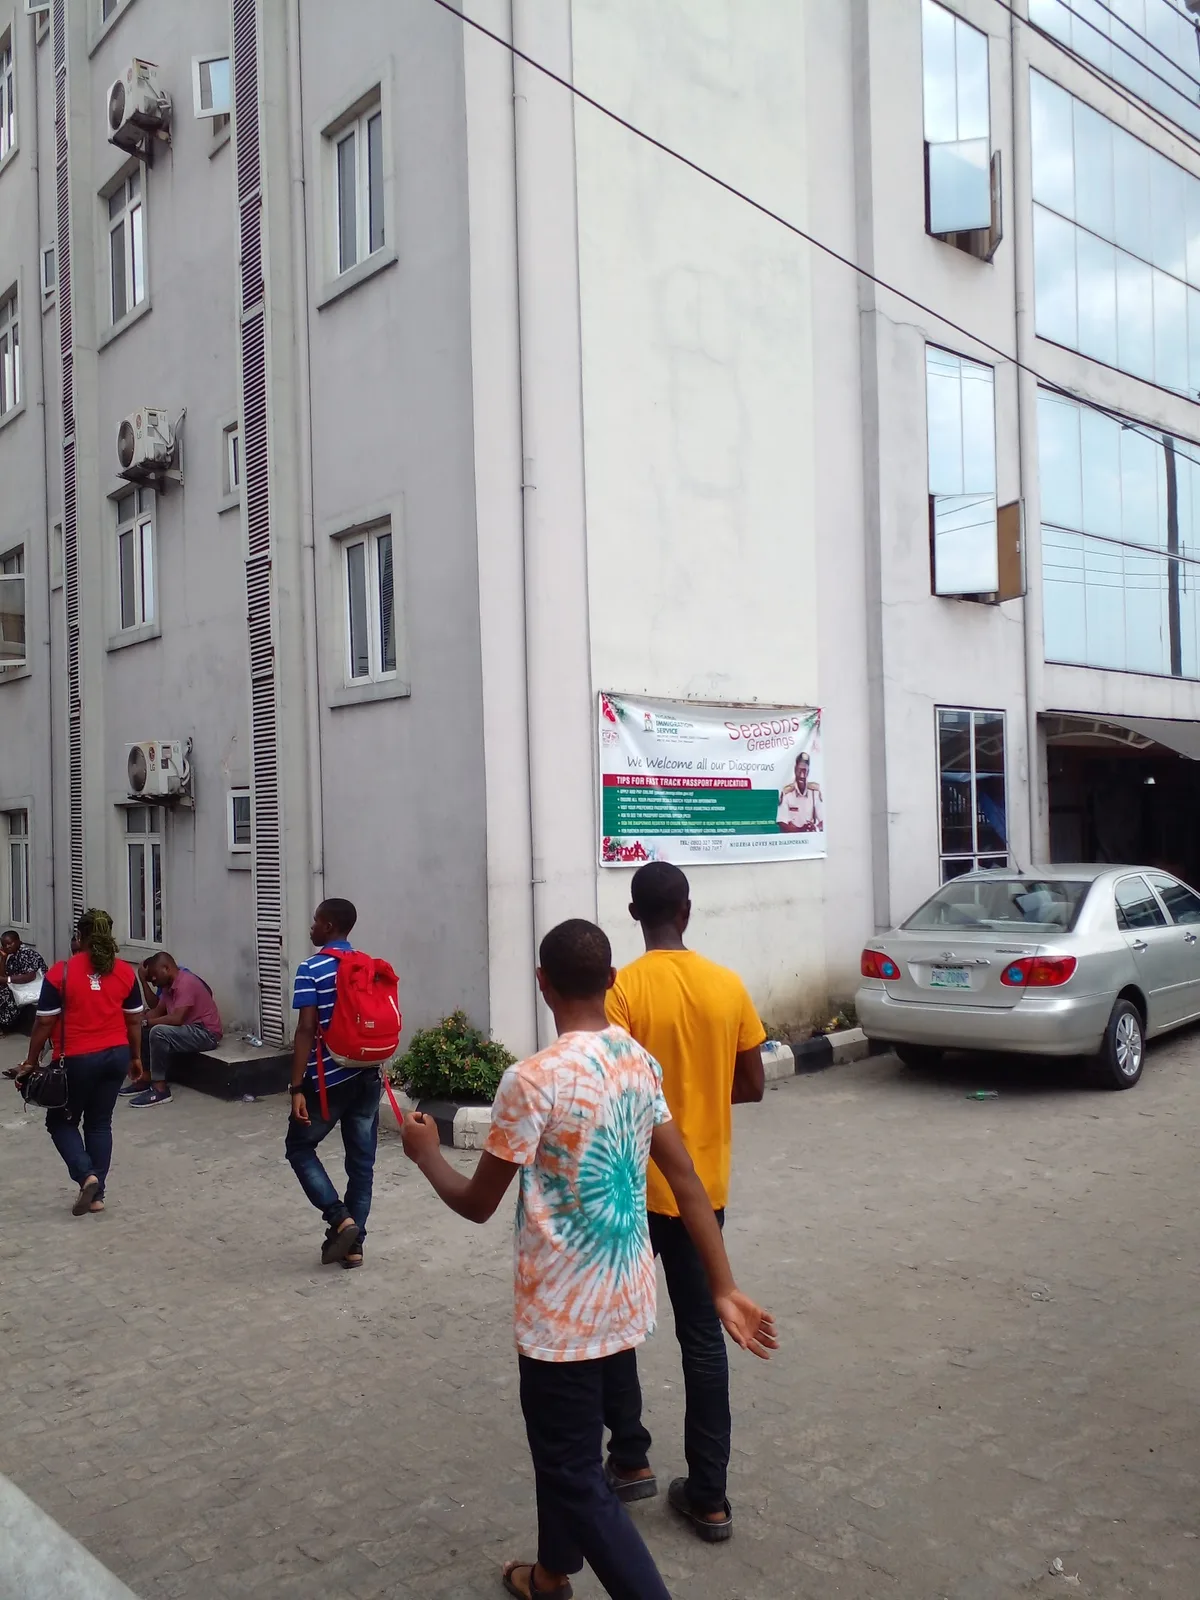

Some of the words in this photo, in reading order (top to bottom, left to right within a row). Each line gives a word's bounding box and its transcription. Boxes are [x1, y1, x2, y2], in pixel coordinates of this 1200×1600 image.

[655, 719, 694, 728] IMMIGRATION
[723, 716, 800, 741] Seasons
[656, 727, 679, 735] SERVICE
[746, 735, 796, 752] Greetings
[626, 755, 642, 768] We
[645, 756, 693, 770] Welcome
[696, 758, 708, 770] all
[710, 761, 726, 772] our
[728, 758, 776, 774] Diasporans
[616, 776, 631, 785] TIPS
[631, 776, 645, 785] FOR
[645, 777, 659, 786] FAST
[660, 778, 681, 786] TRACK
[682, 778, 713, 787] PASSPORT
[713, 779, 749, 788] APPLICATION
